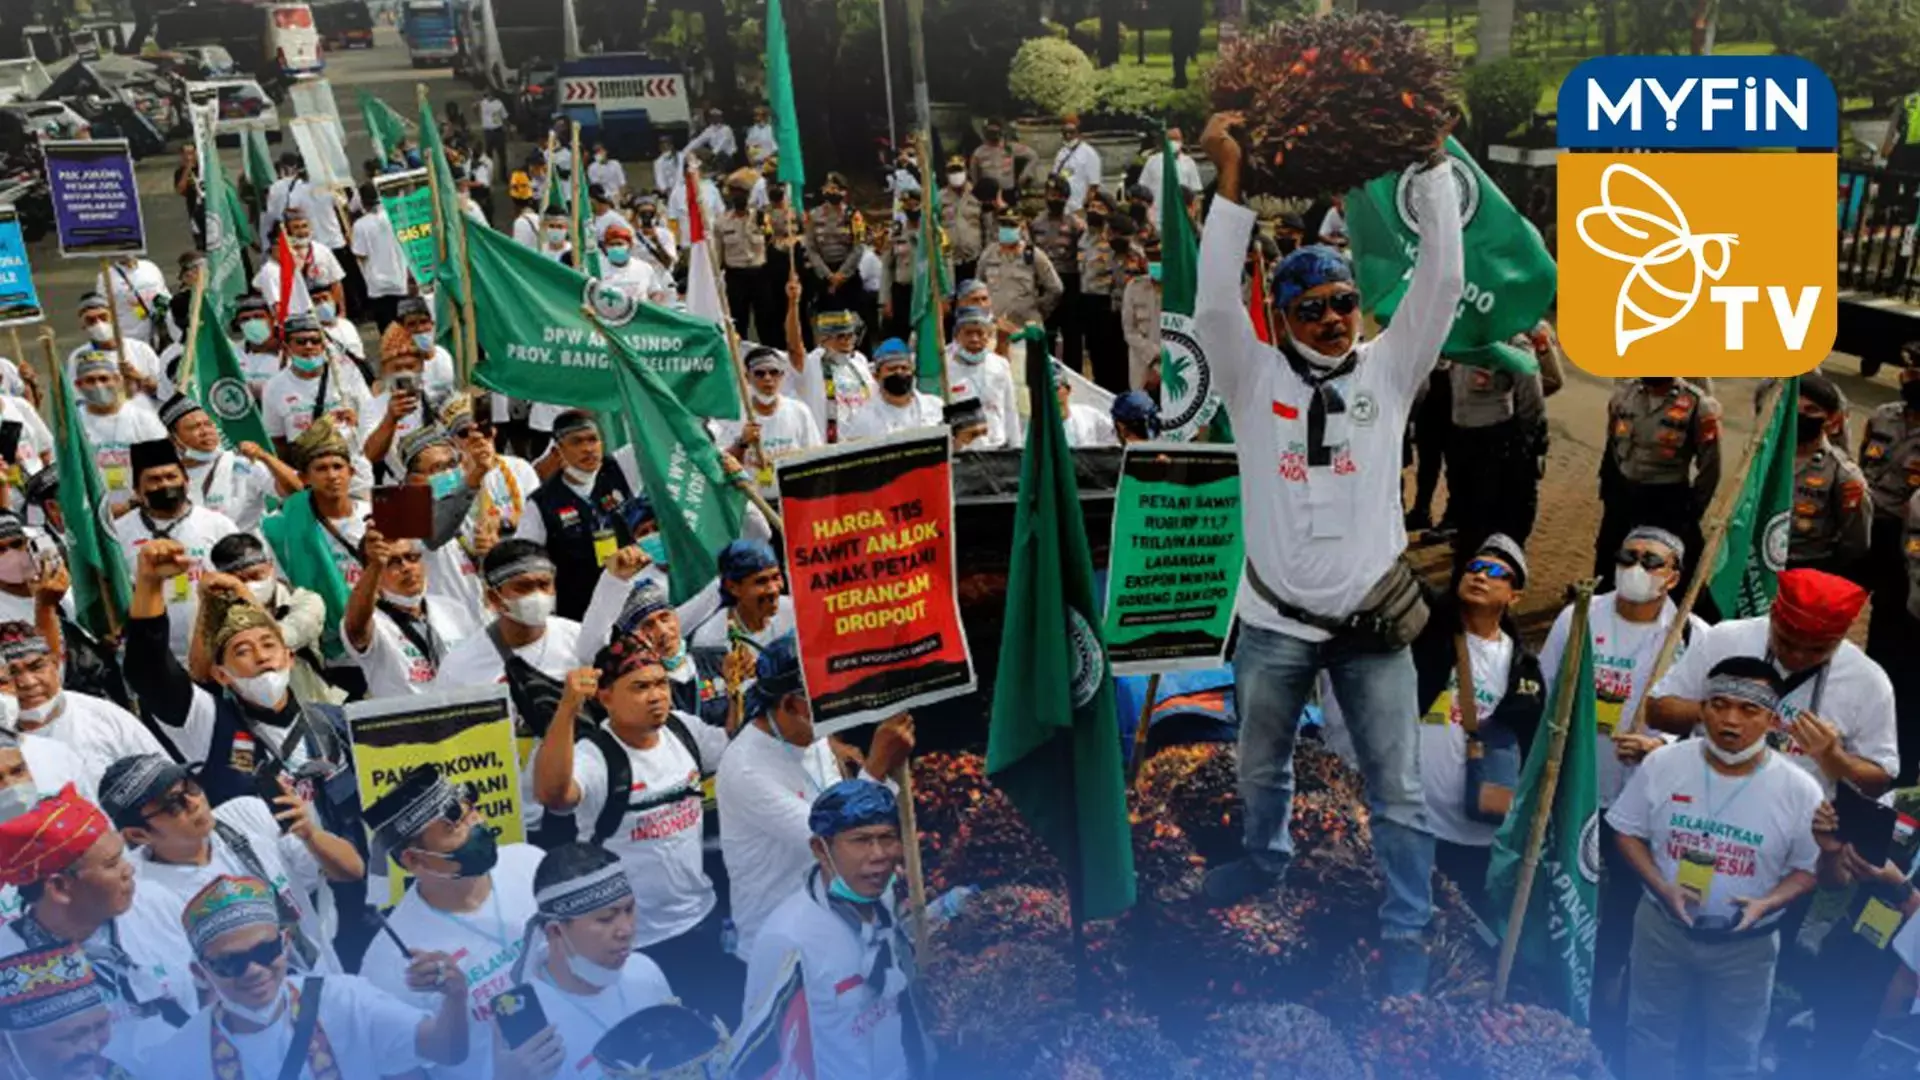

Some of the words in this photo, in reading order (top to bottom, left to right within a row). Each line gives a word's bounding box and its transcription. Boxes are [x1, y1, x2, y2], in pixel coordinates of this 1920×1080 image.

[543, 326, 583, 345] DPW
[507, 343, 555, 366] PROV.
[1138, 494, 1192, 509] PETANI
[812, 509, 886, 540] HARGA
[795, 537, 861, 567] SAWIT
[1145, 554, 1216, 570] LARANGAN
[811, 565, 868, 592] ANAK
[873, 547, 937, 579] PETANI
[1125, 572, 1177, 589] EKSPOR
[1180, 569, 1226, 585] MINYAK
[823, 573, 931, 613] TERANCAM
[835, 599, 926, 636] DROPOUT
